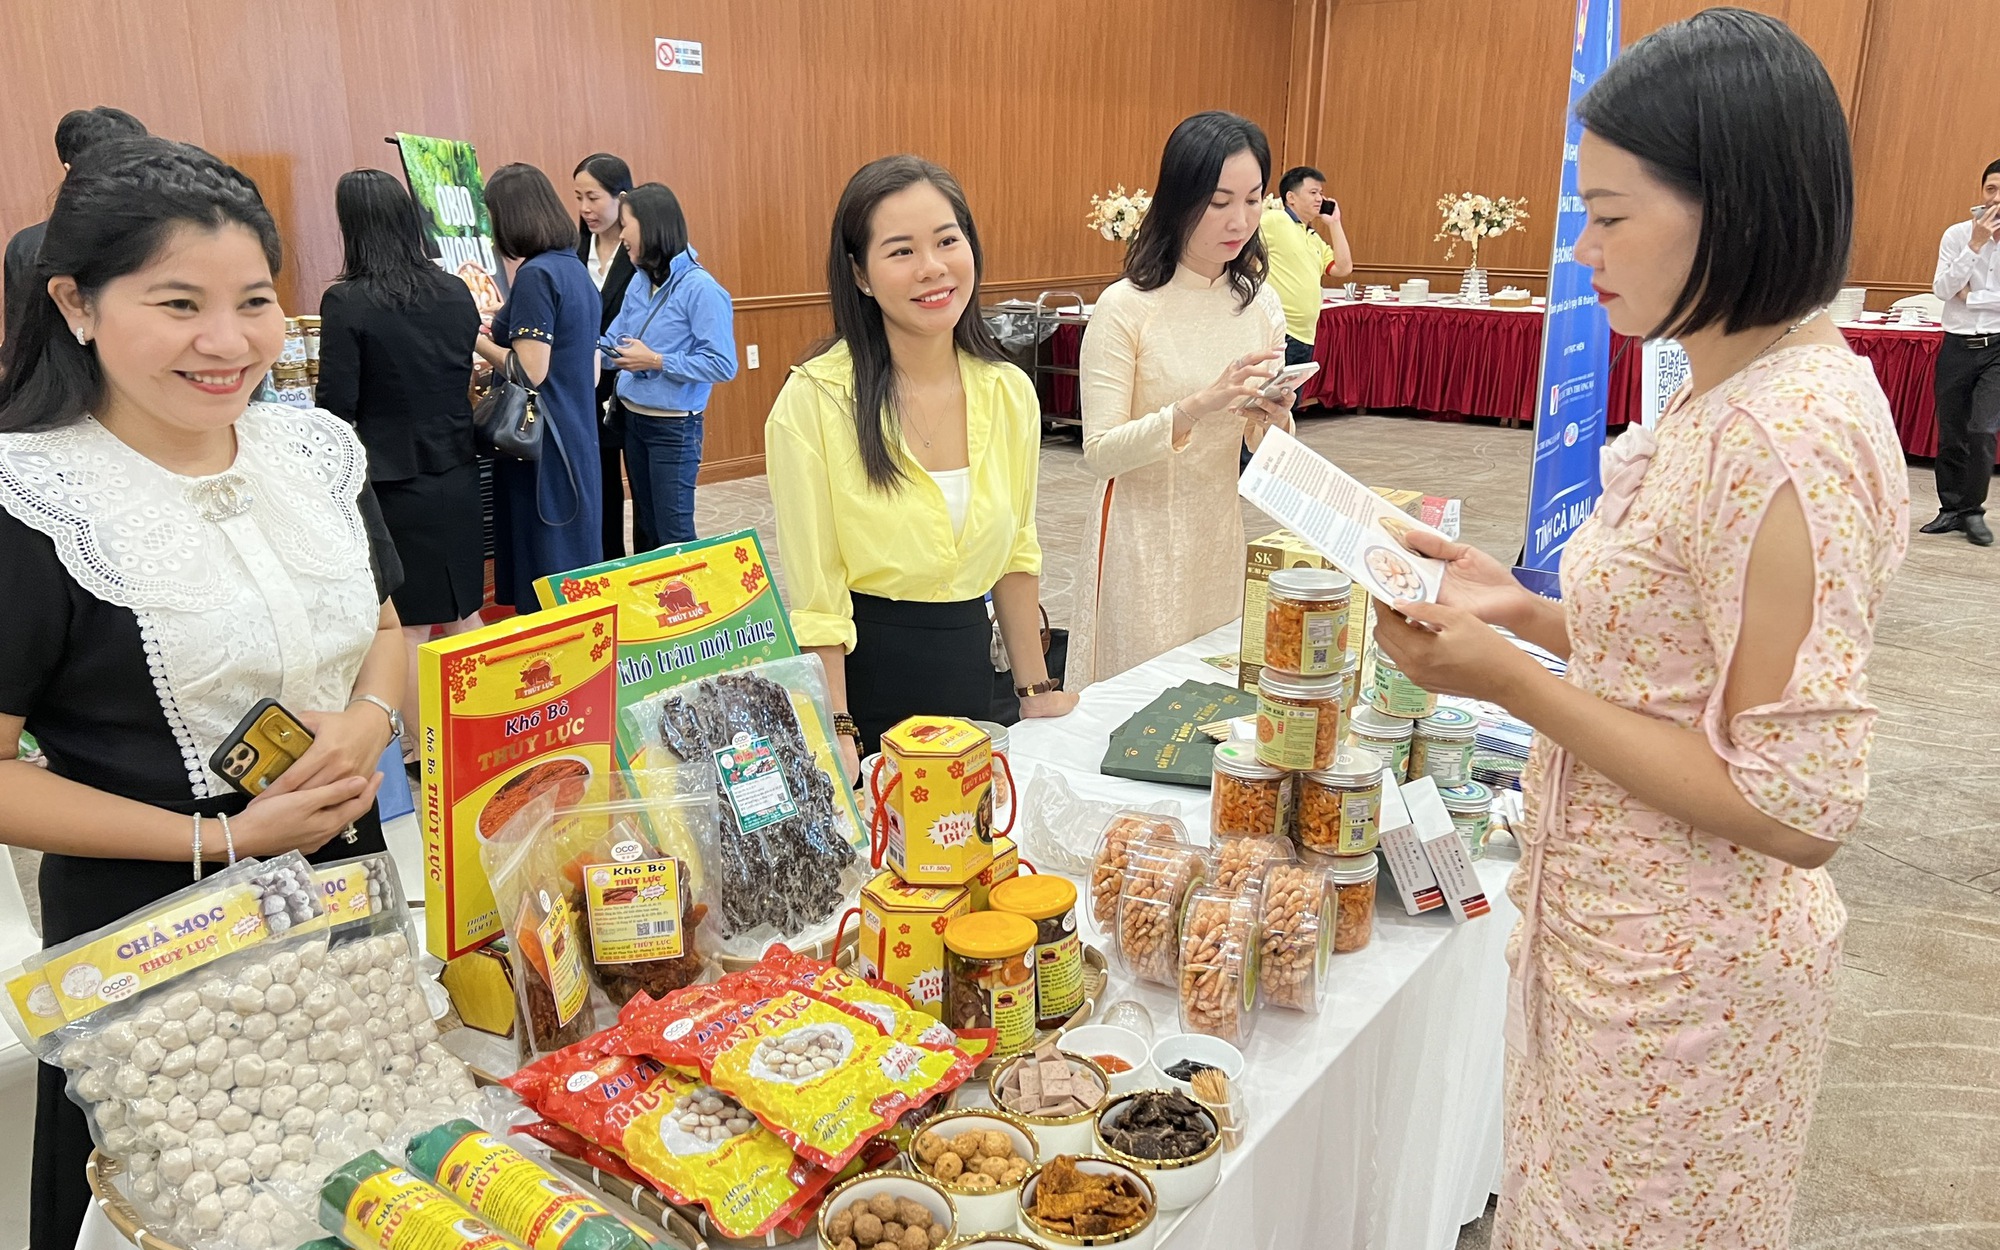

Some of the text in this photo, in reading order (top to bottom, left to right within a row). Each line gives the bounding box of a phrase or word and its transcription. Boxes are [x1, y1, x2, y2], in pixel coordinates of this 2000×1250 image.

[435, 184, 476, 226] OBIO
[435, 235, 497, 275] WORLD
[1535, 496, 1591, 554] TỈNH CÀ MAU
[1254, 552, 1273, 565] SK
[617, 615, 777, 687] khô trâu một nắng
[505, 699, 569, 738] Khô Bò
[545, 716, 586, 746] LỰC
[425, 726, 443, 883] Khô Bò THÚY LỰC
[615, 845, 639, 854] OCOP
[613, 863, 667, 876] Khô Bò
[322, 878, 347, 897] ỌC
[116, 923, 170, 960] CHẢ
[172, 906, 225, 938] MỌC
[102, 975, 133, 994] OCOP
[481, 1151, 500, 1167] LỤA
[393, 1187, 412, 1207] LỤA
